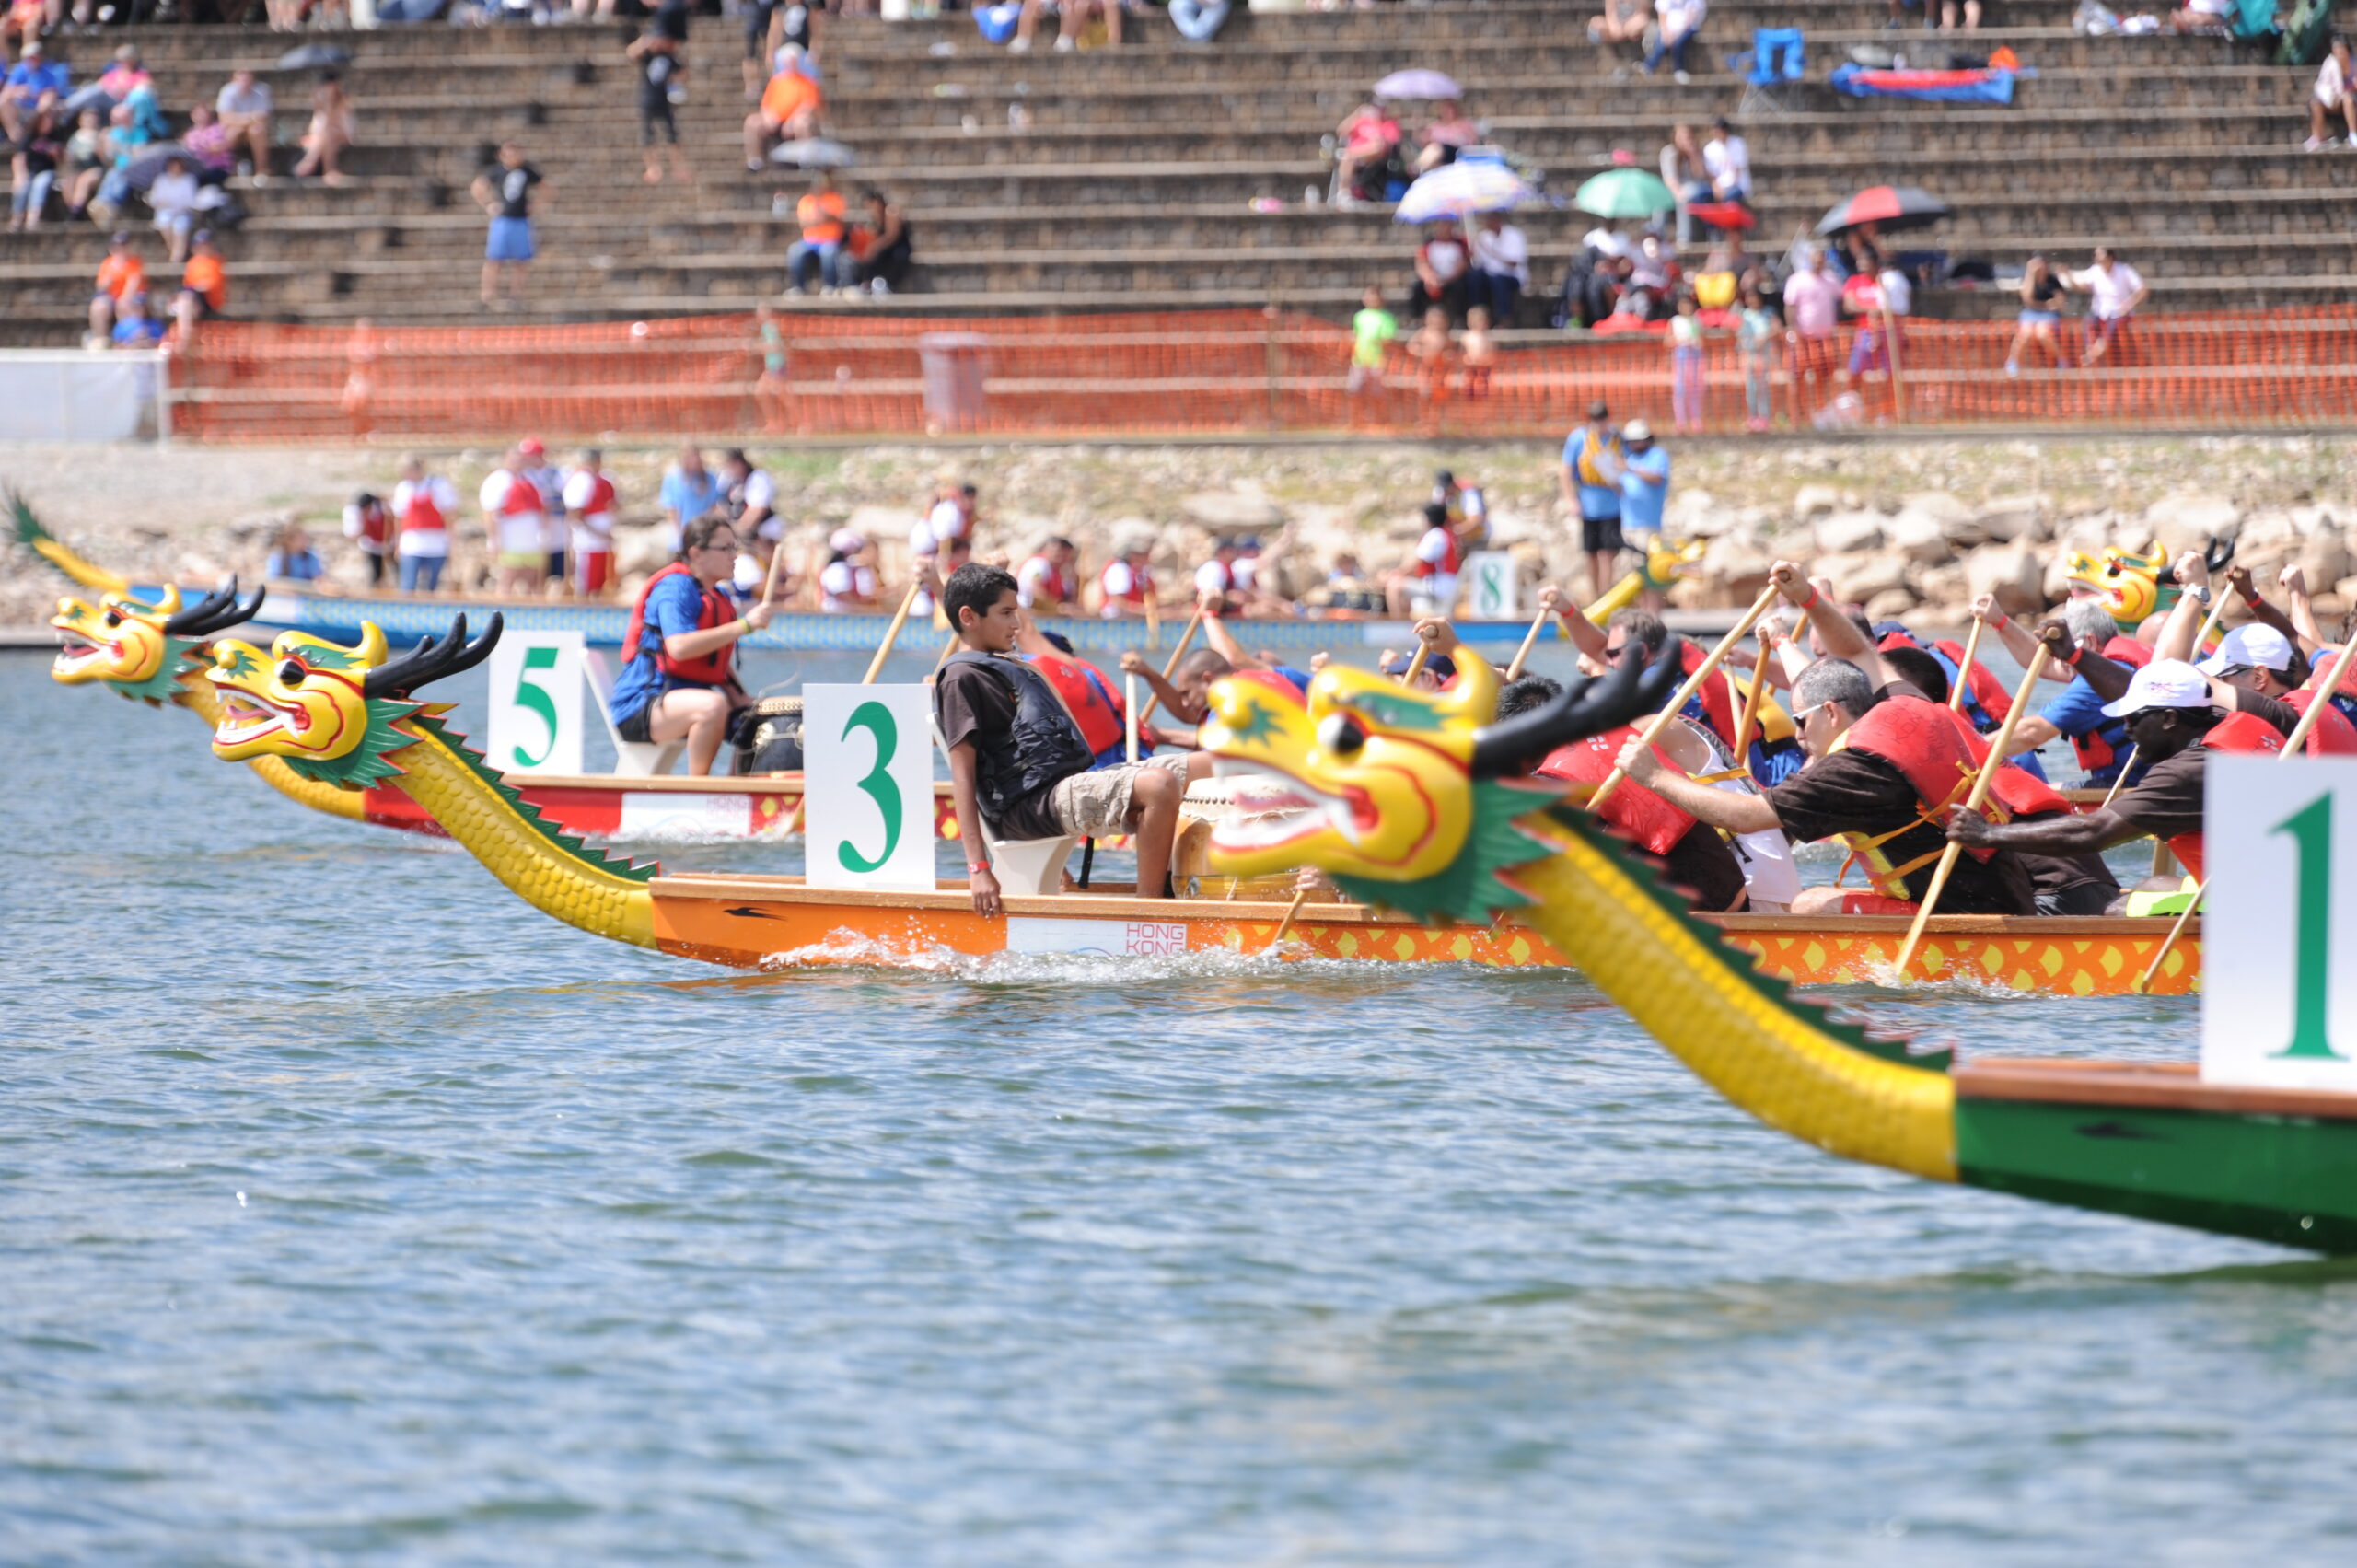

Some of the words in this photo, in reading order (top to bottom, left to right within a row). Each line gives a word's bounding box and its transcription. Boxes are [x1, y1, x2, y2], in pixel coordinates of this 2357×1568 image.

[1480, 558, 1503, 617] 8
[512, 647, 559, 767] 5
[838, 701, 902, 873] 3
[1126, 923, 1184, 940] HONG
[2261, 789, 2351, 1061] 1
